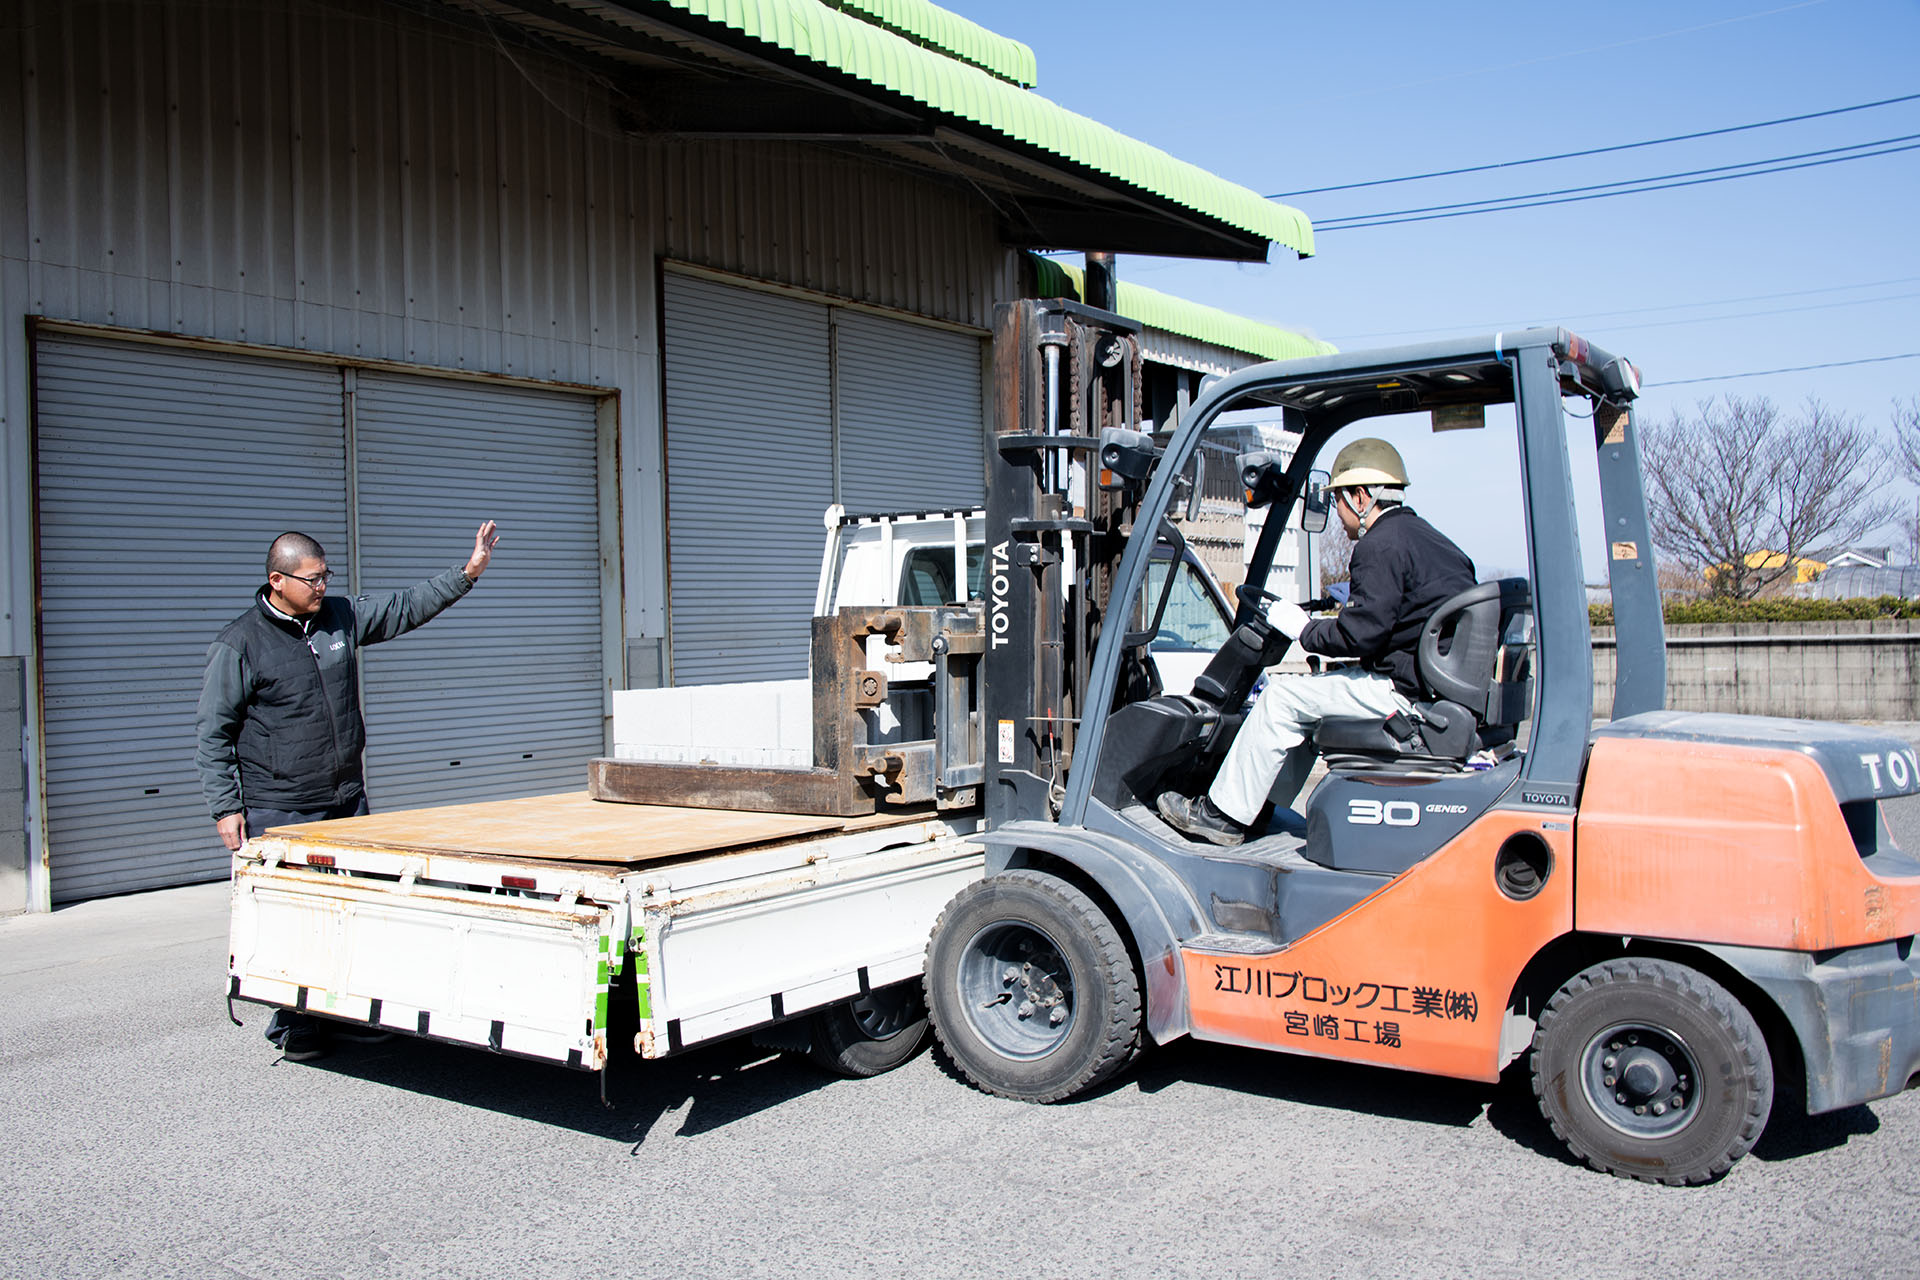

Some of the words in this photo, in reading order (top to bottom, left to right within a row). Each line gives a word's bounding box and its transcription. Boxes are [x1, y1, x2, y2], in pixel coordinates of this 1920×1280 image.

[992, 540, 1010, 649] TOYOTA
[1347, 799, 1420, 827] 30
[1425, 804, 1468, 814] GENEO
[1525, 793, 1567, 805] TOYOTA
[1214, 963, 1479, 1023] 江川ブロック工業(株)
[1284, 1010, 1402, 1049] 宮崎工場
